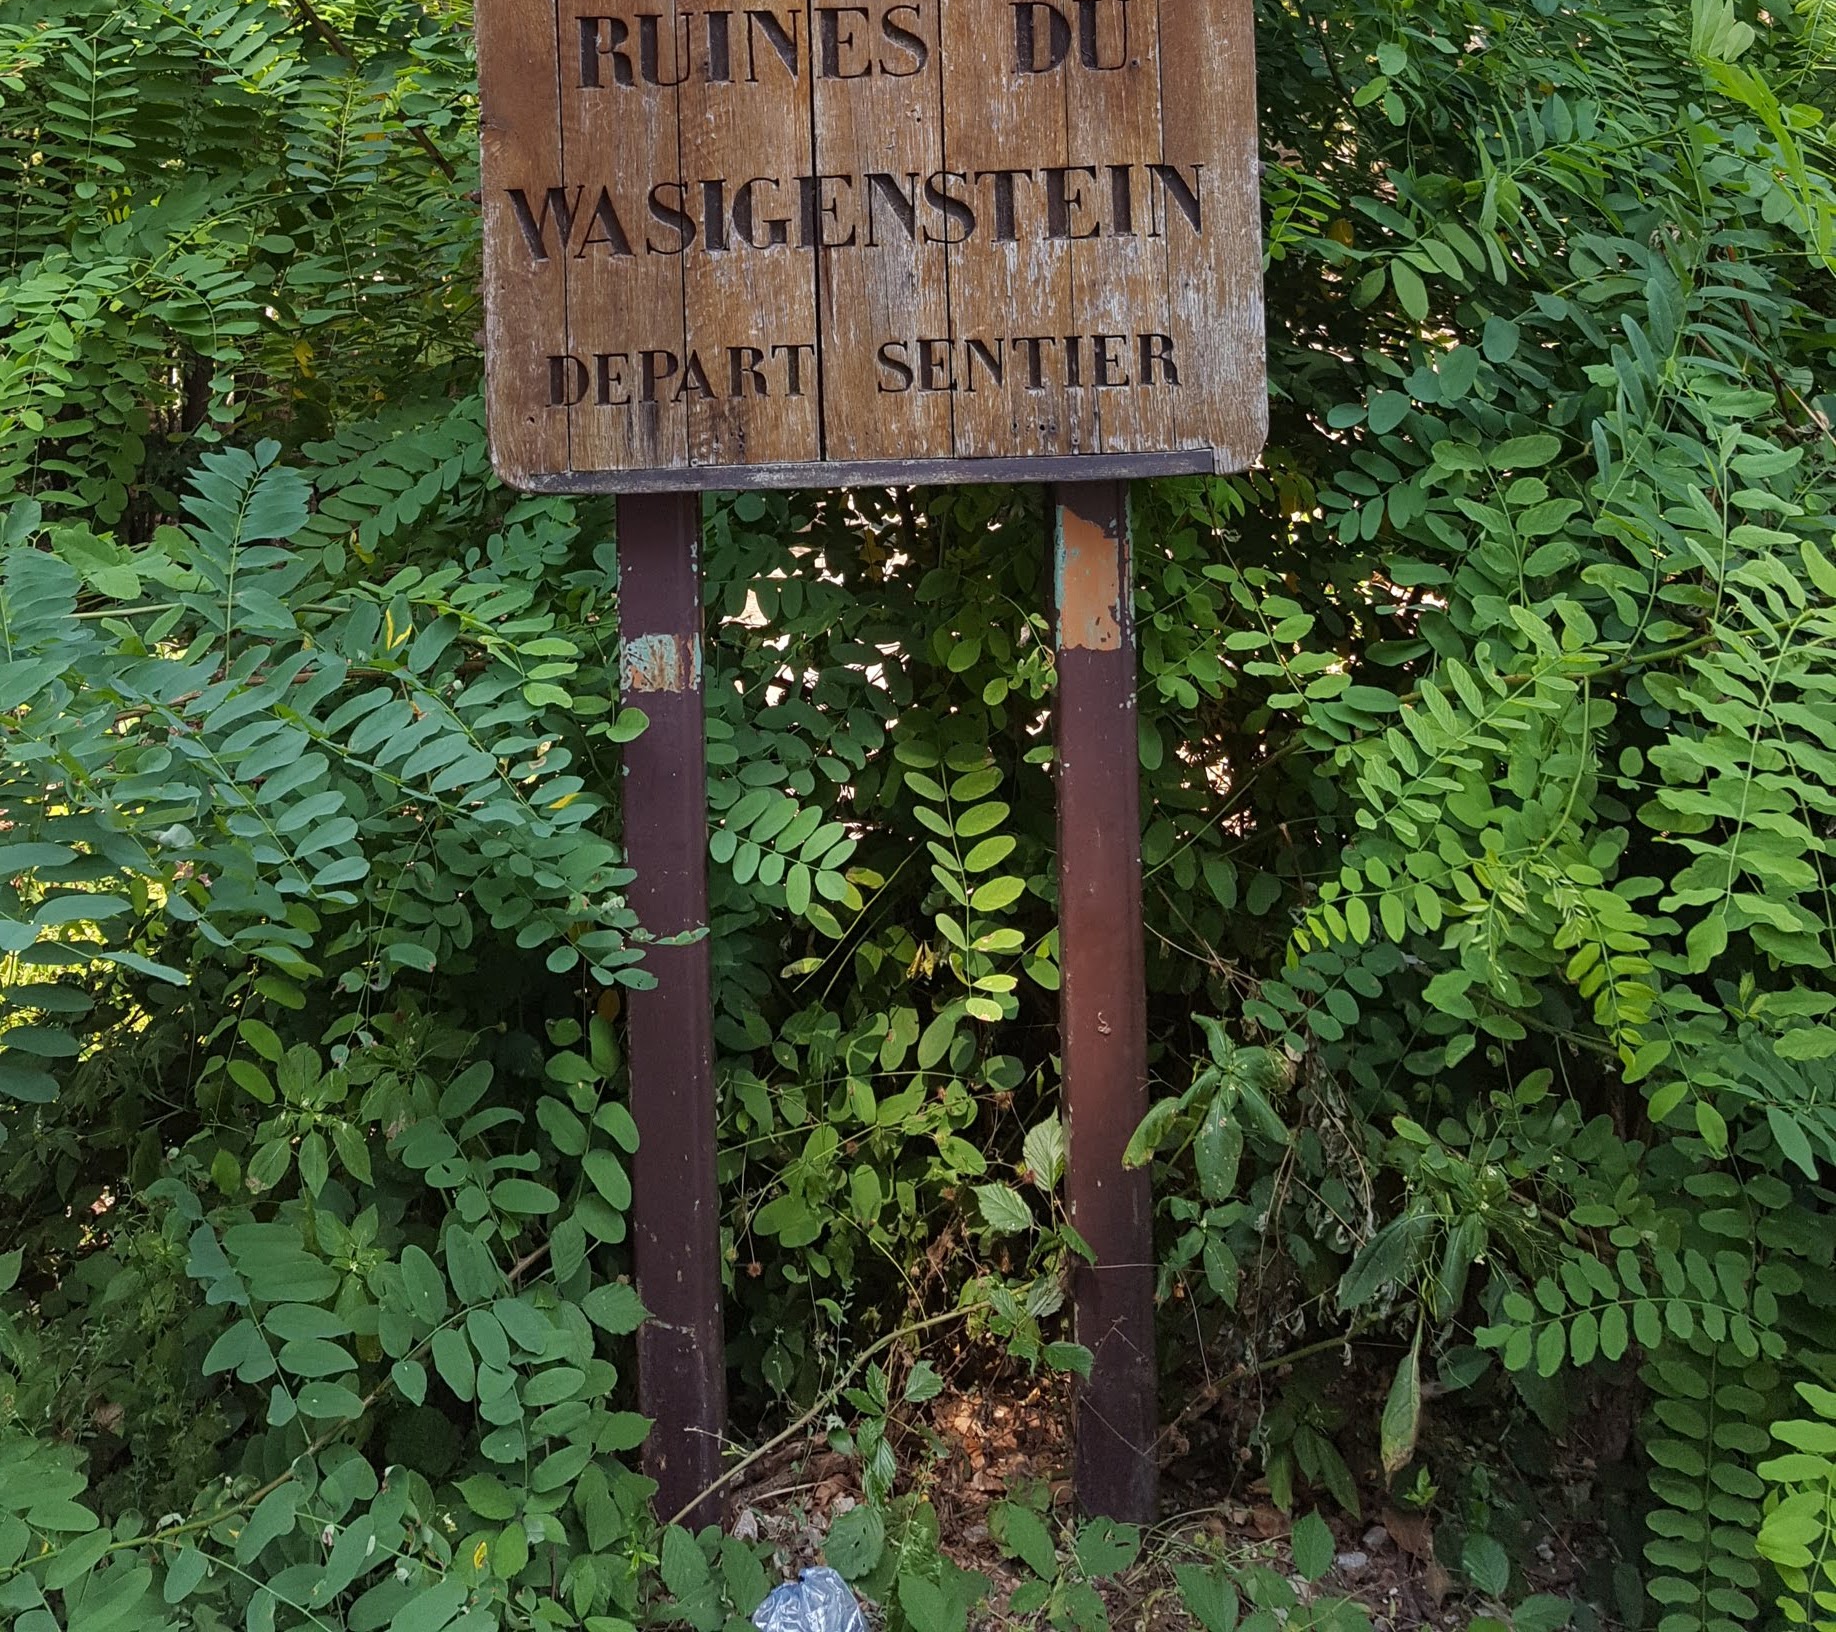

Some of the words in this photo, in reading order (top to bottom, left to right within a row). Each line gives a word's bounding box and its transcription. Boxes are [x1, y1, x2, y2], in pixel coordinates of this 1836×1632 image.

[576, 5, 928, 90] RUINES
[508, 163, 1204, 262] WASIGENSTEIN
[548, 345, 813, 408] DEPART
[877, 334, 1182, 394] SENTIER
